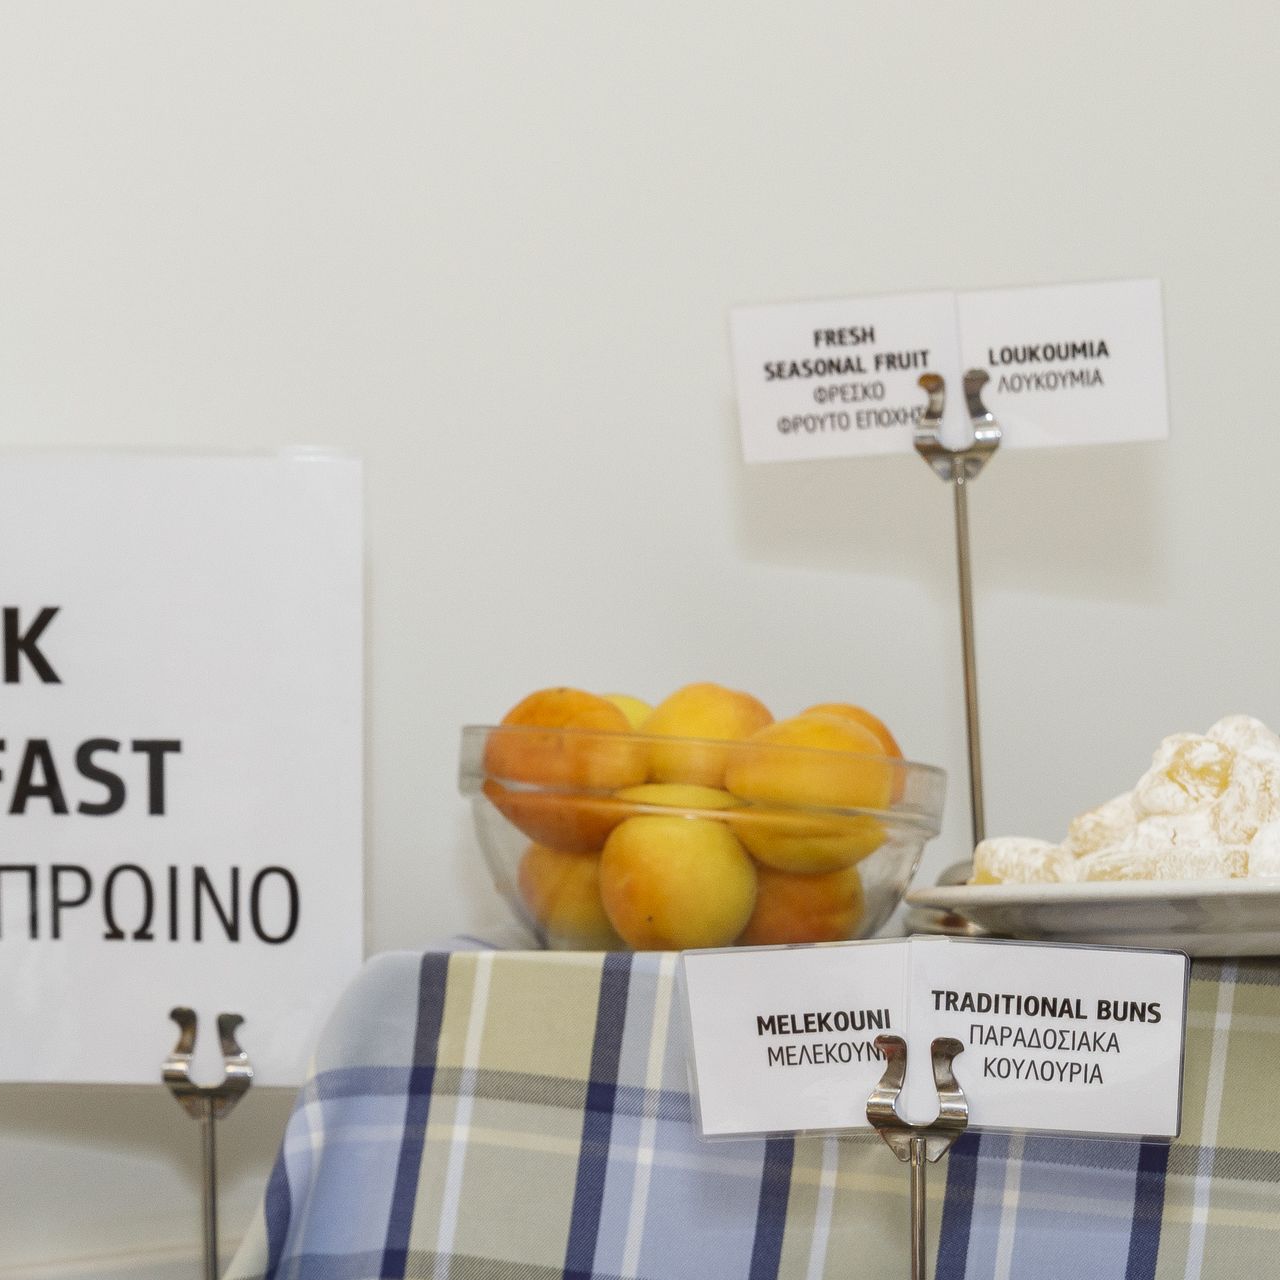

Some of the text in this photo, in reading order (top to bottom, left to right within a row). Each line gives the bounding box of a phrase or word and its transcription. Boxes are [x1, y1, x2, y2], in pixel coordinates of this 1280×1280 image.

[813, 326, 875, 348] FRESH
[763, 350, 929, 381] SEASONAL FRUIT
[988, 340, 1110, 367] LOUKOUMIA
[812, 380, 886, 404] ΦΡΕΣΚΟ
[997, 369, 1105, 394] ΛΟΥΚΟΥΜΙΑ
[776, 411, 851, 435] ΦΡΟΥΤΟ
[931, 989, 1162, 1024] TRADITIONAL BUNS
[757, 1008, 891, 1036] MELEKOUNI
[969, 1023, 1121, 1053] ΠΑΡΑΔΟΣΙΑΚΑ
[983, 1056, 1104, 1085] ΚΟΥΛΟΥΡΙΑ
